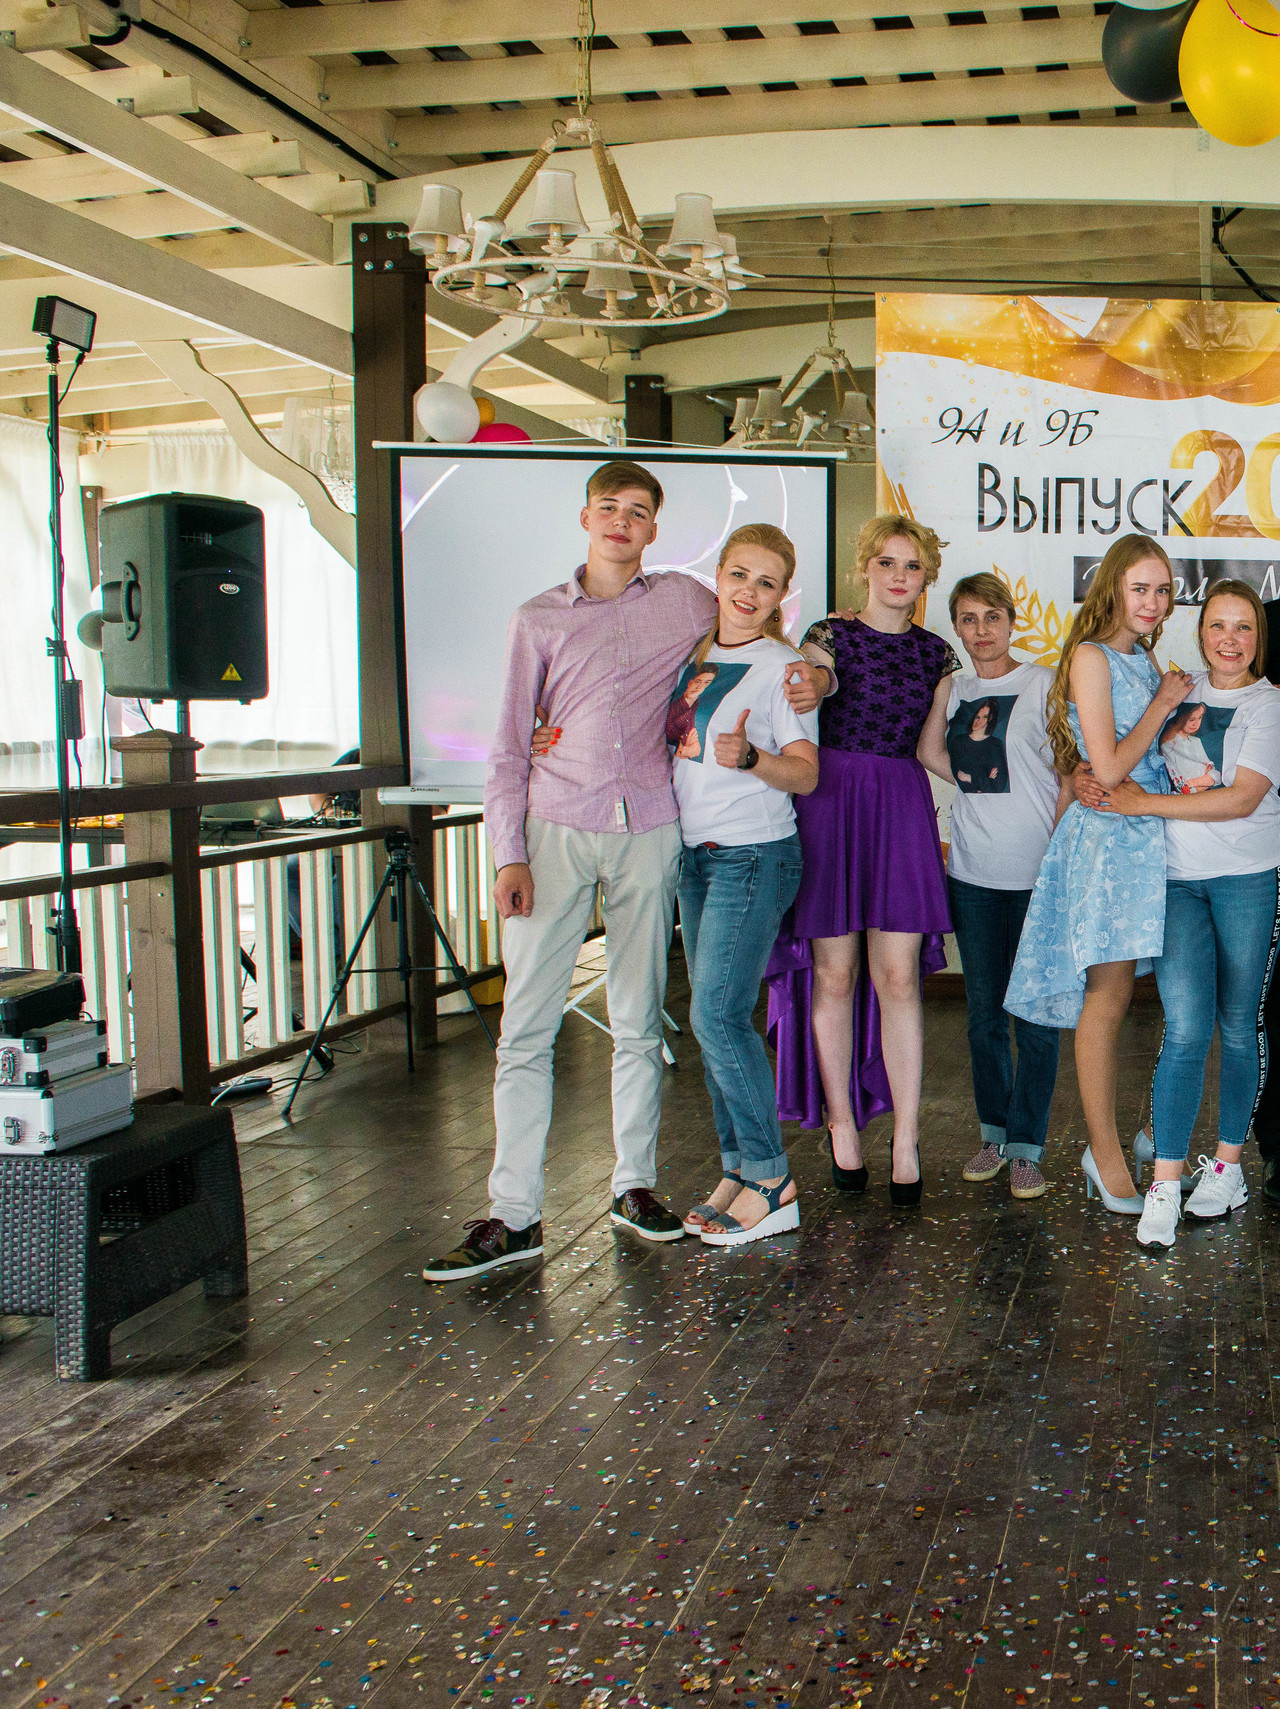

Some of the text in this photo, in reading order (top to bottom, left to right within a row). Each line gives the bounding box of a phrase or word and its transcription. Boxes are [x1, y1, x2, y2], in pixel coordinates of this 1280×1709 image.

[931, 406, 1100, 447] 9А и 9Б
[1266, 947, 1276, 971] GOOD
[1257, 1003, 1265, 1027] LET'S
[1258, 1031, 1266, 1056] GOOD
[1260, 1057, 1266, 1069] BE
